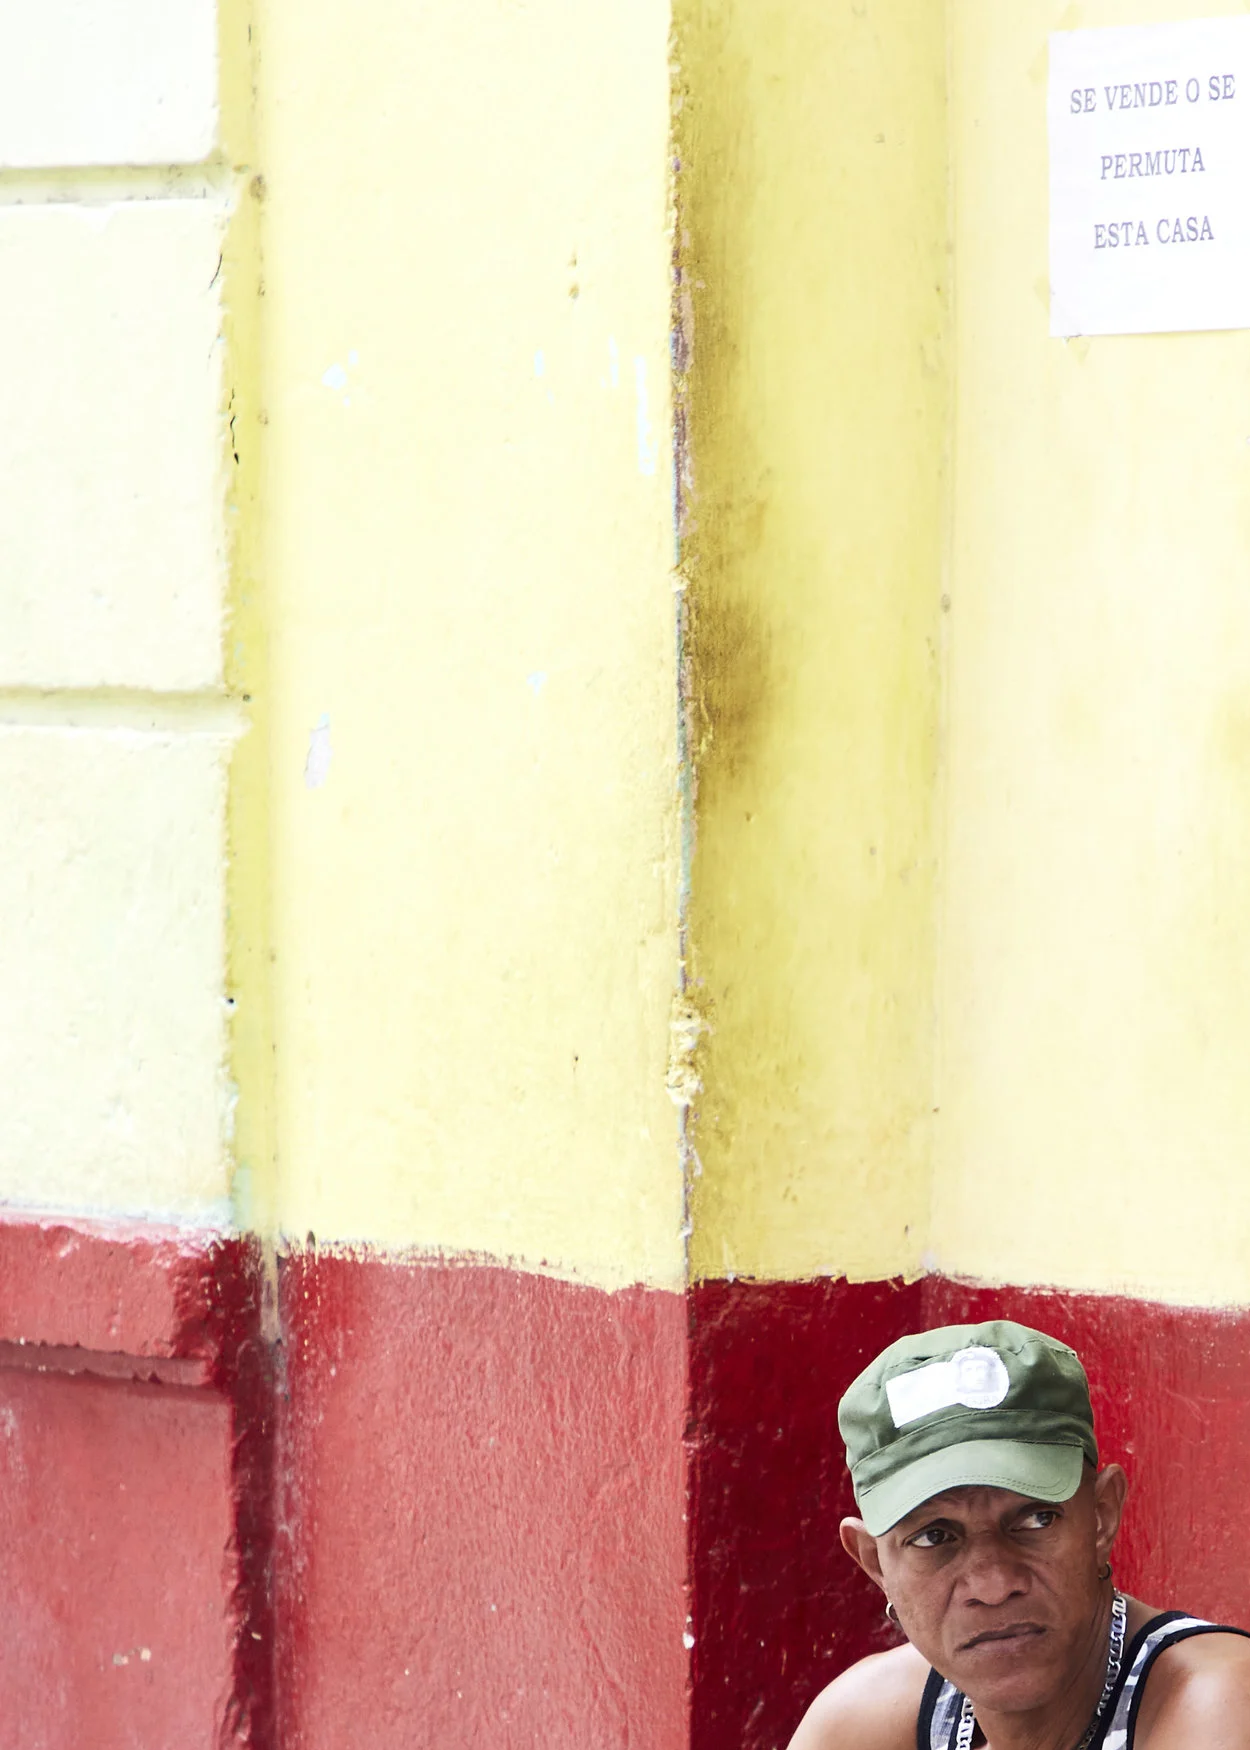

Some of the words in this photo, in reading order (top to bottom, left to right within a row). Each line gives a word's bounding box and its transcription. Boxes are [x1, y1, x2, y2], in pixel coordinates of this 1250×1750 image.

[1069, 88, 1097, 114] SE
[1104, 80, 1178, 111] VENDE
[1186, 77, 1201, 103] O
[1208, 74, 1237, 101] SE
[1100, 147, 1206, 180] PERMUTA
[1094, 220, 1149, 249] ESTA
[1156, 215, 1215, 245] CASA
